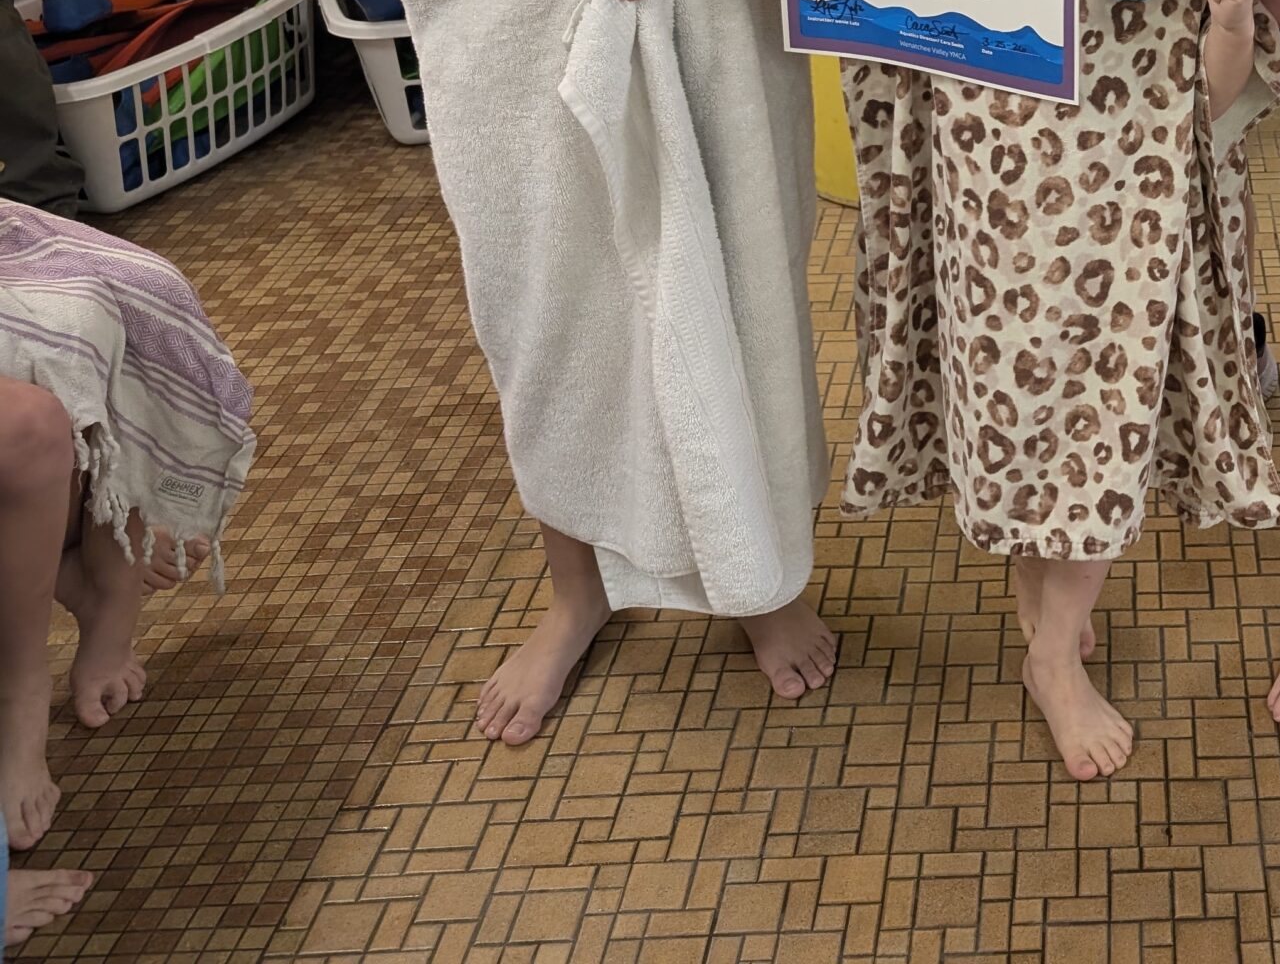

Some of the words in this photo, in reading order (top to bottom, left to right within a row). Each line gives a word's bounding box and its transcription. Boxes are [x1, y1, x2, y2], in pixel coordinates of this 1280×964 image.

[900, 40, 931, 53] Wenatchee
[933, 47, 949, 56] Valley
[949, 50, 966, 60] YMCA
